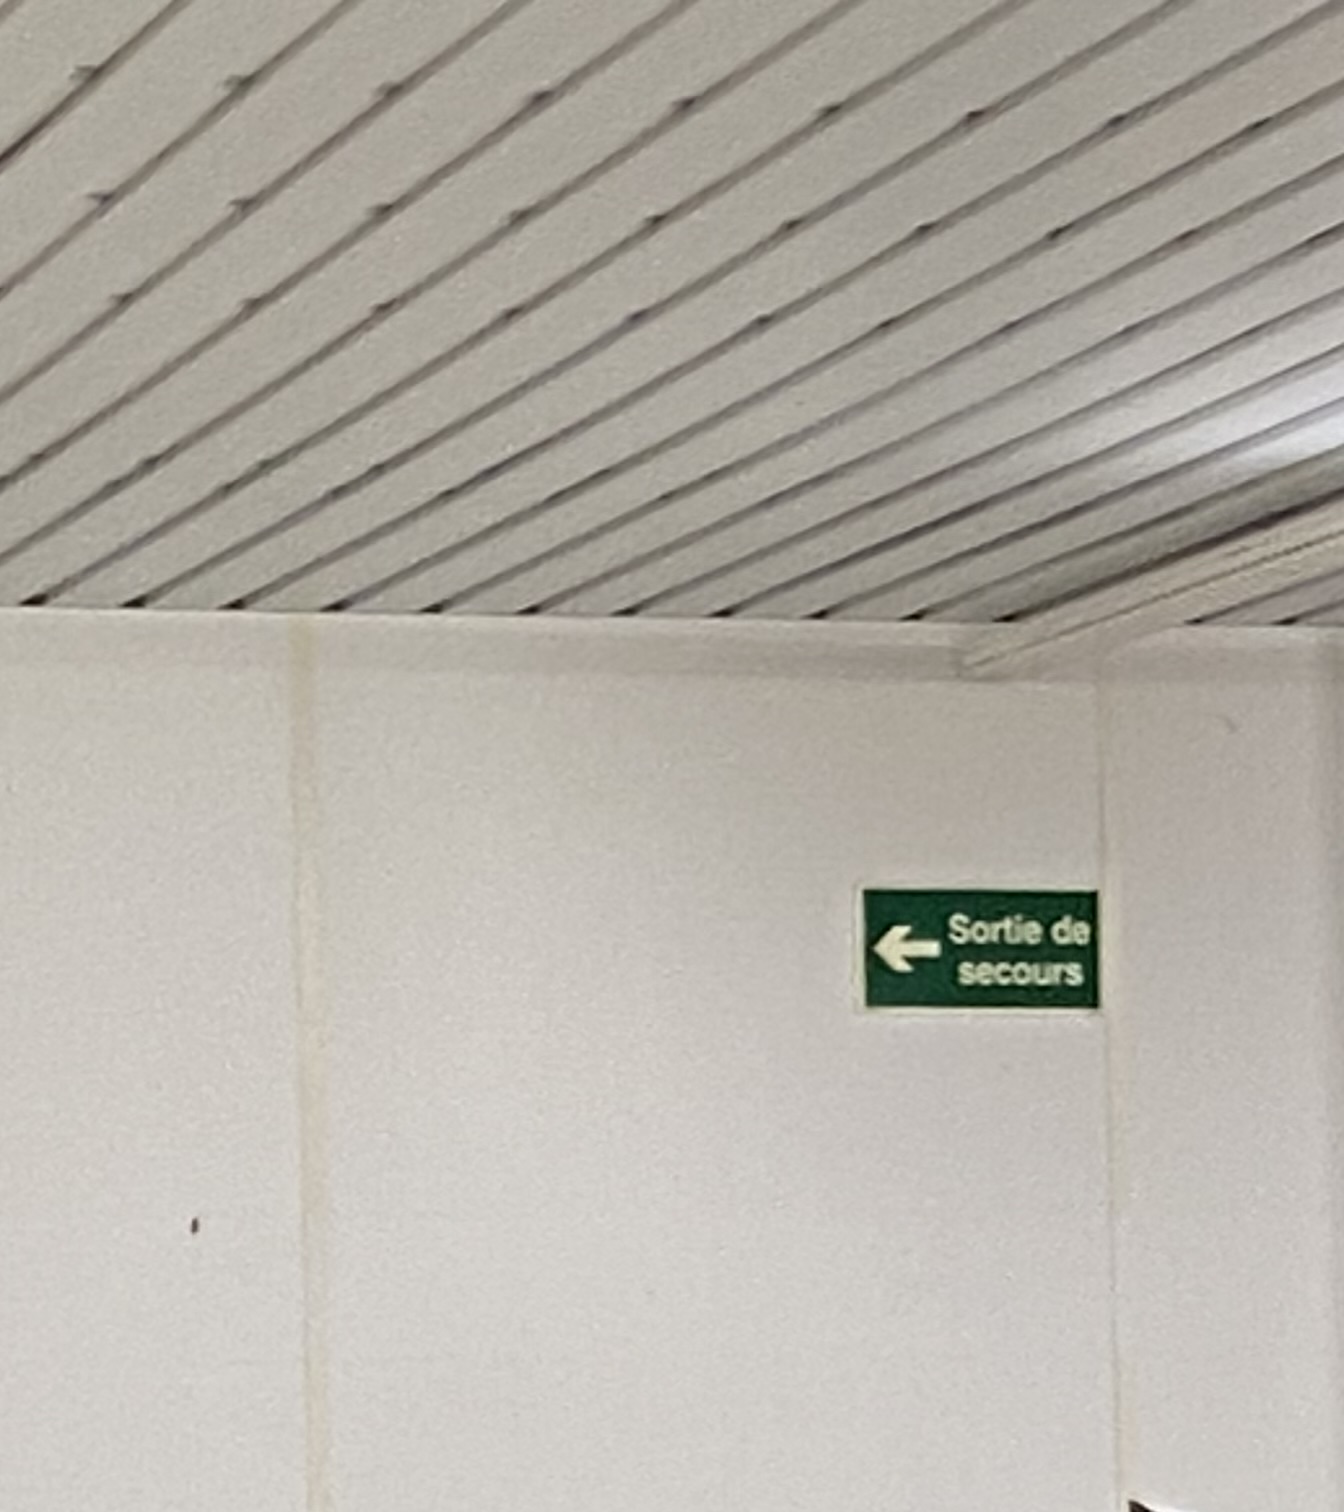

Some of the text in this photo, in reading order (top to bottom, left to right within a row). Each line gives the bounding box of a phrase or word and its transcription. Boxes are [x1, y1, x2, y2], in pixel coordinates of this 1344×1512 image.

[948, 912, 1091, 945] Sortie de
[958, 961, 1084, 986] secours
